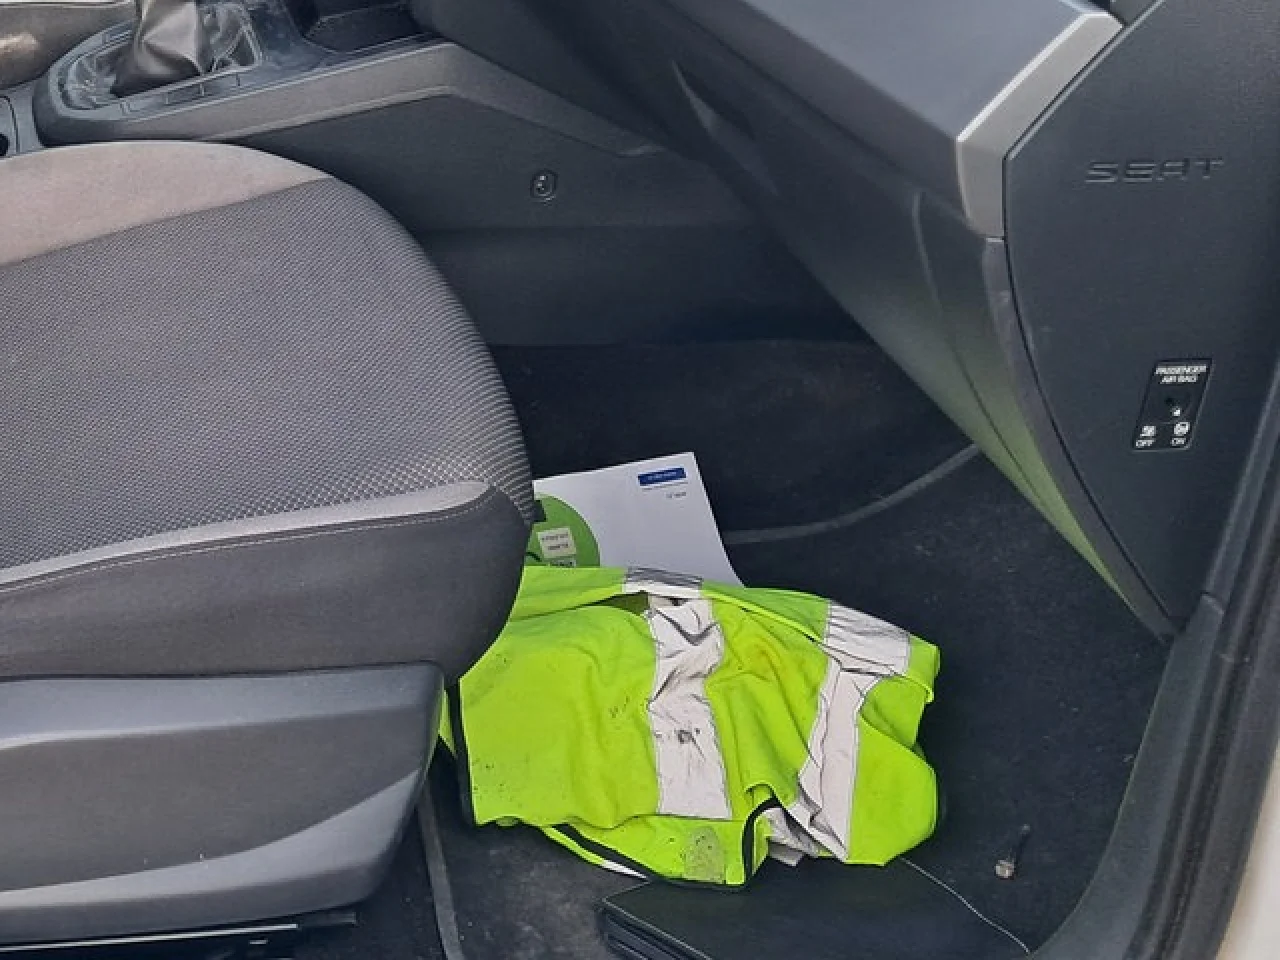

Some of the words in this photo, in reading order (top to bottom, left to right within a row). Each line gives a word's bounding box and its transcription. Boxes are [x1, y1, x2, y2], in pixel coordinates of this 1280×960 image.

[1085, 157, 1224, 183] SEAT
[1135, 439, 1155, 447] OFF
[1171, 437, 1187, 446] ON
